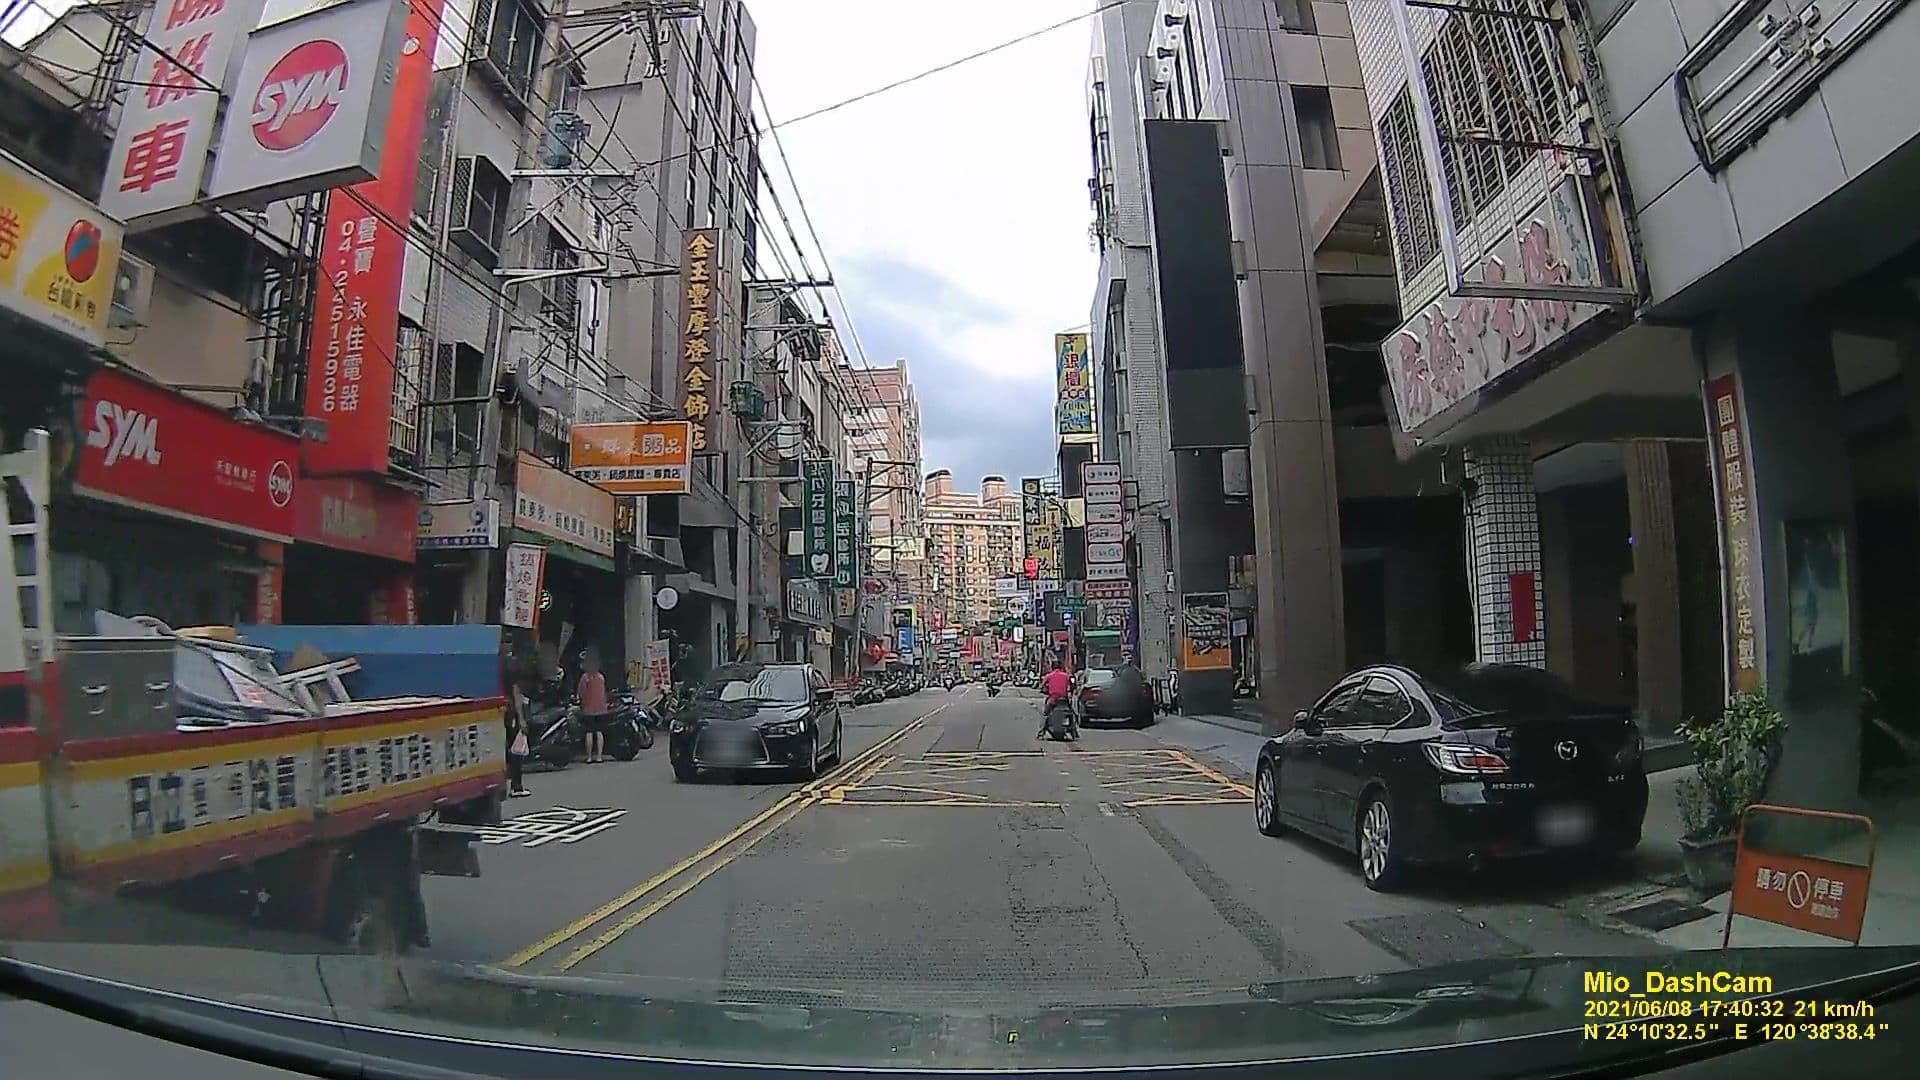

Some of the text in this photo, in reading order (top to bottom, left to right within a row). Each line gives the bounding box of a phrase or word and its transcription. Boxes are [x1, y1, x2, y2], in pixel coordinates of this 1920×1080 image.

[249, 64, 345, 132] SYM
[87, 400, 162, 466] SYM
[270, 474, 293, 496] SYM
[1756, 867, 1844, 900] 請勿 停車
